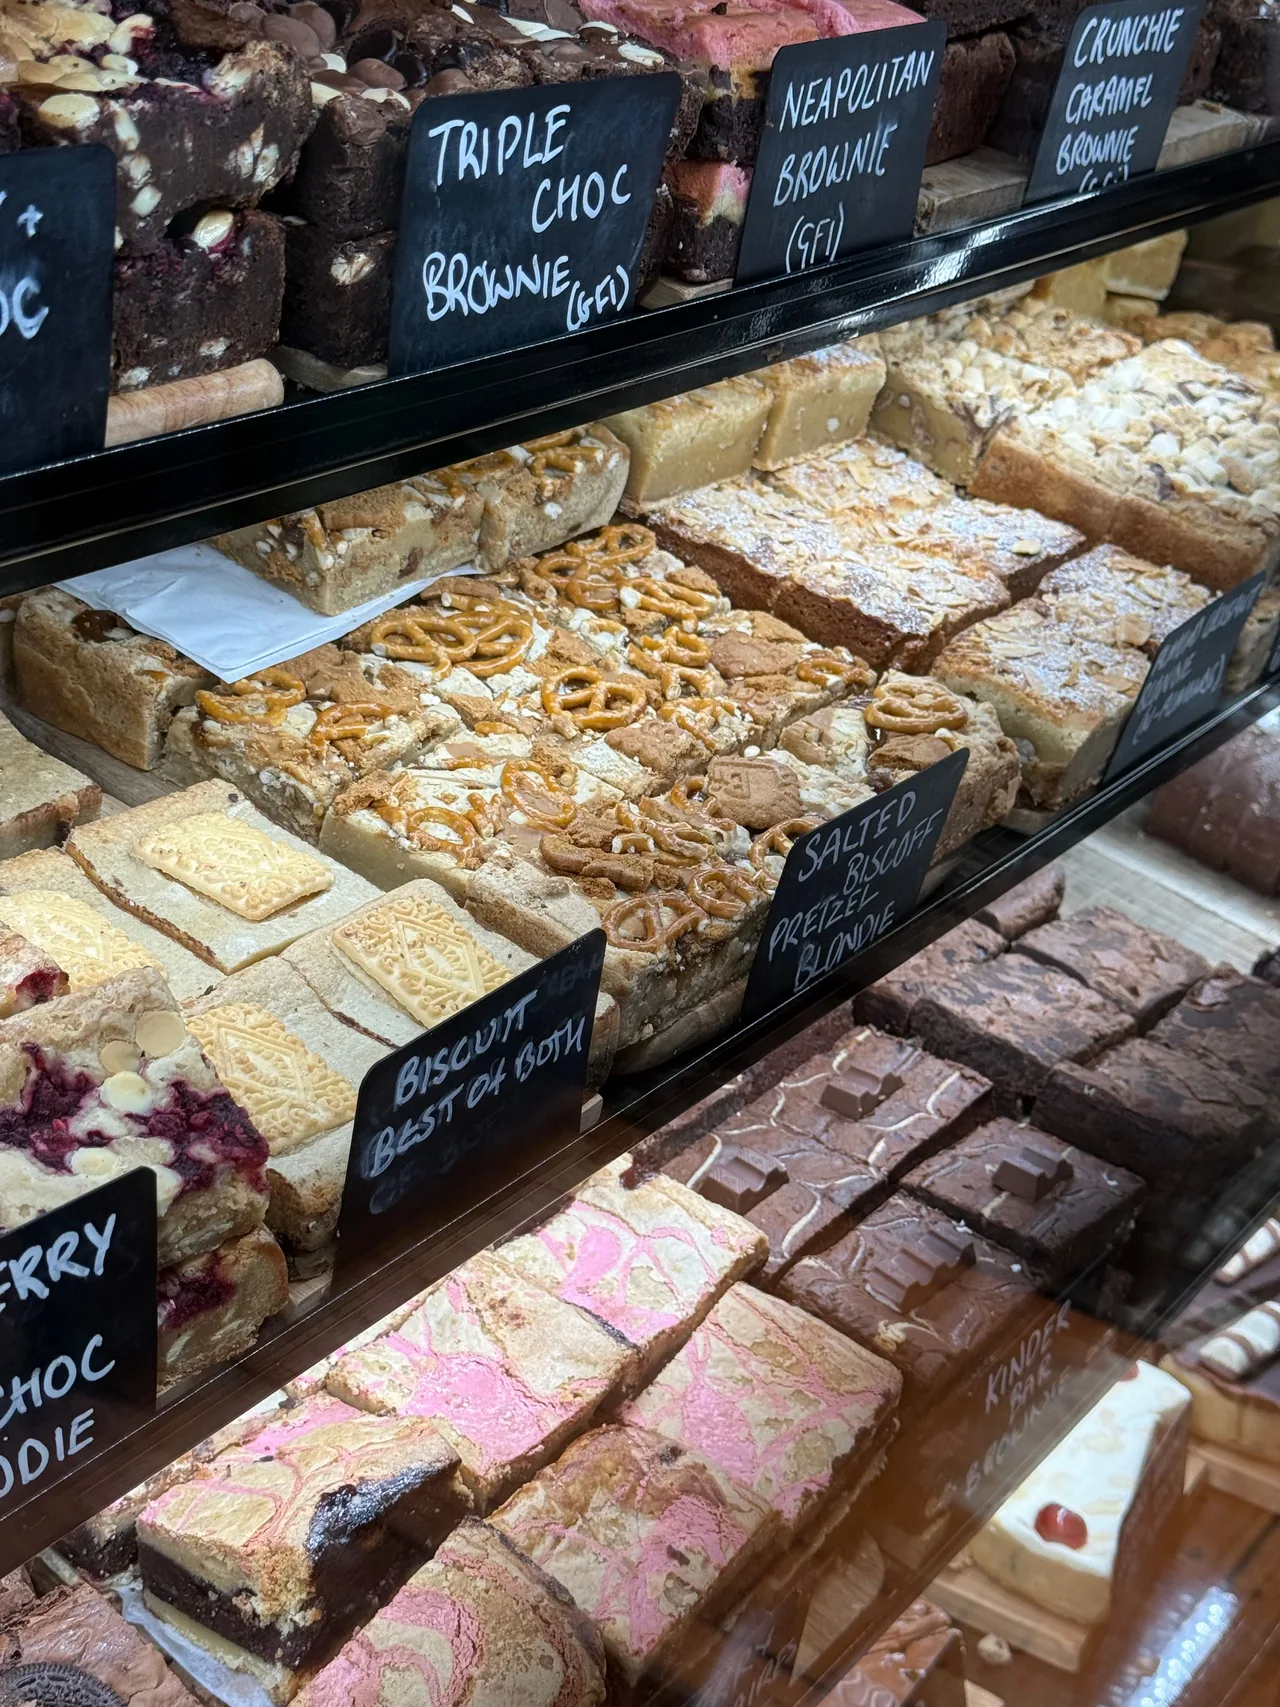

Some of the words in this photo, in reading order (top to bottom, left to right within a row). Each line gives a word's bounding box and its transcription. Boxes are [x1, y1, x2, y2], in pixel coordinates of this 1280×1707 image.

[1073, 7, 1185, 69] CRUNCHIE
[778, 49, 935, 133] NEAPOLITAN
[1065, 72, 1154, 126] CARAMEL
[428, 104, 571, 187] TRIPLE
[772, 122, 899, 208] BROWNIE
[1055, 124, 1139, 176] BROWNIE
[531, 163, 632, 234] CHOC
[422, 251, 571, 322] BROWNIE
[797, 790, 917, 884] SALTED
[842, 808, 944, 895] BISCOFF
[768, 884, 880, 963] PRETZEL
[793, 900, 895, 993] BLONDIE
[393, 989, 539, 1113] BISCUIT
[366, 1083, 465, 1179] BEST
[515, 1016, 586, 1083] BOTH
[985, 1298, 1072, 1415] KINDER
[1009, 1352, 1052, 1425] BAR
